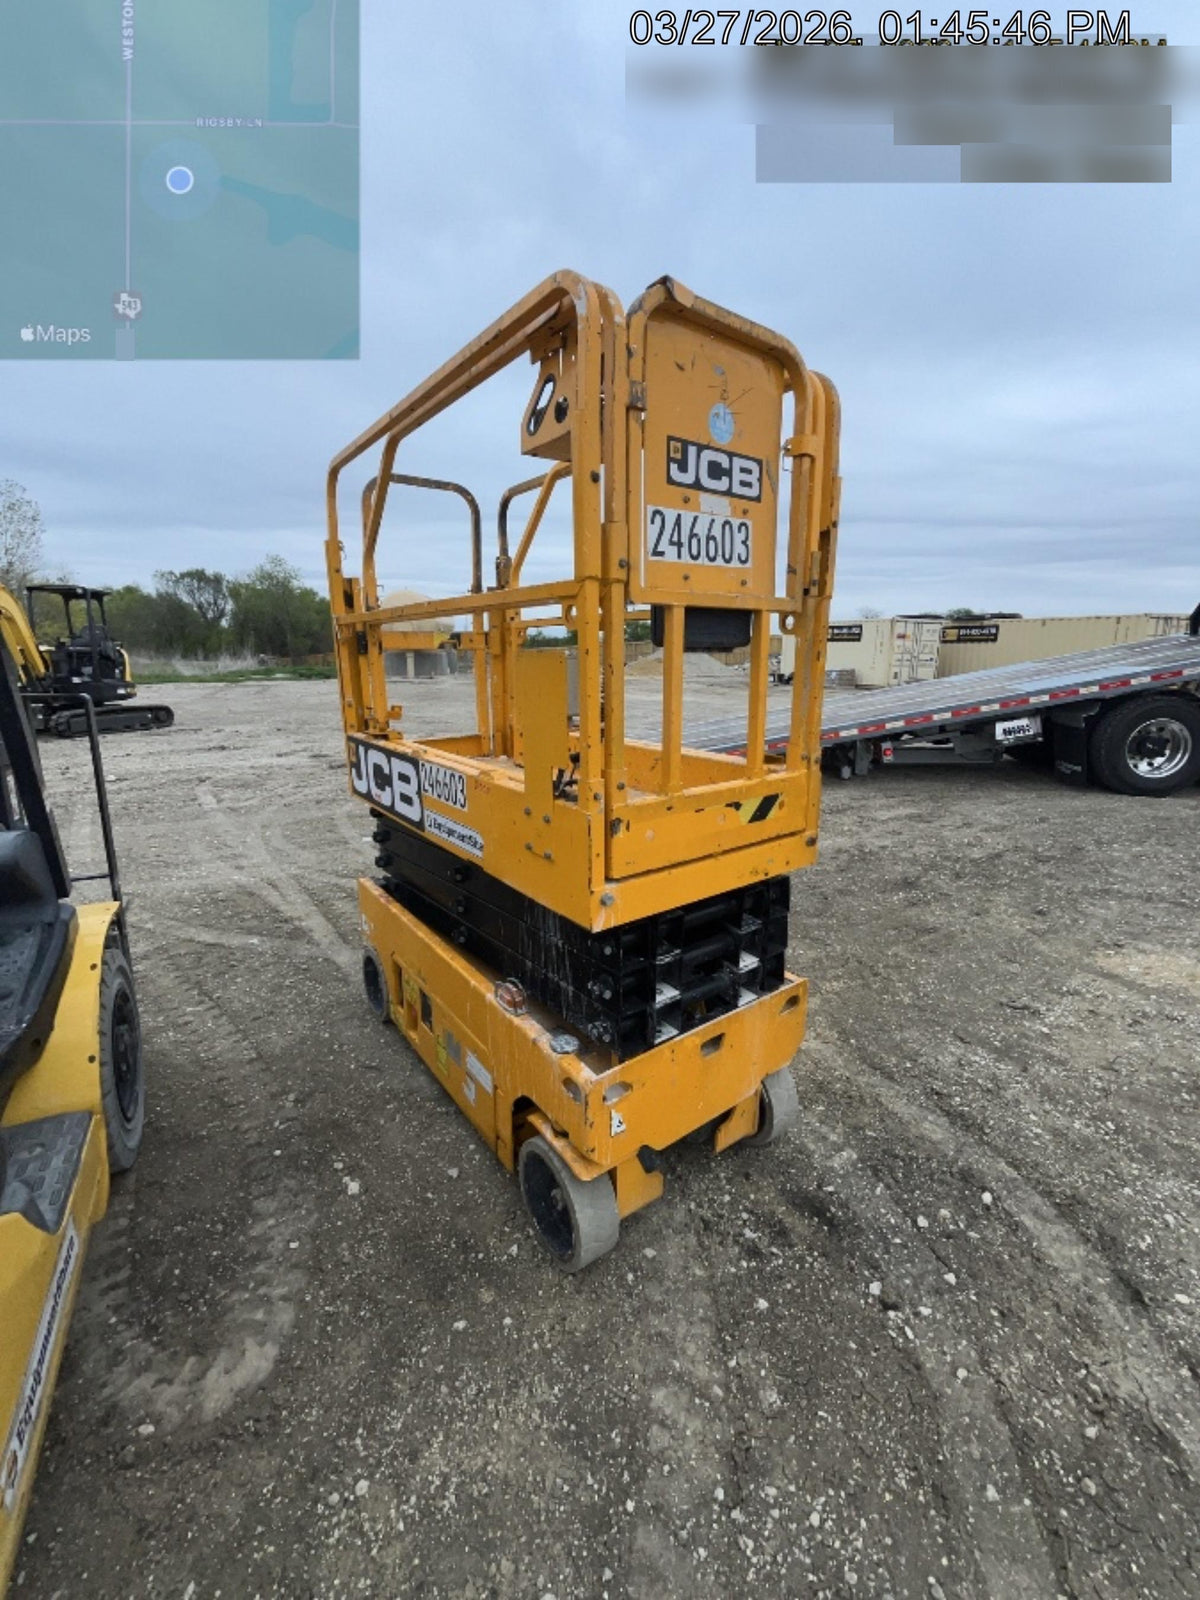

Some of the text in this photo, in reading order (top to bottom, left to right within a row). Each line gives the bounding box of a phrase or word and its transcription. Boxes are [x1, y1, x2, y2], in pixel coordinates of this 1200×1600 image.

[669, 444, 761, 498] JCB
[650, 509, 750, 565] 246603
[351, 744, 422, 823] JCB
[420, 763, 467, 809] 246603
